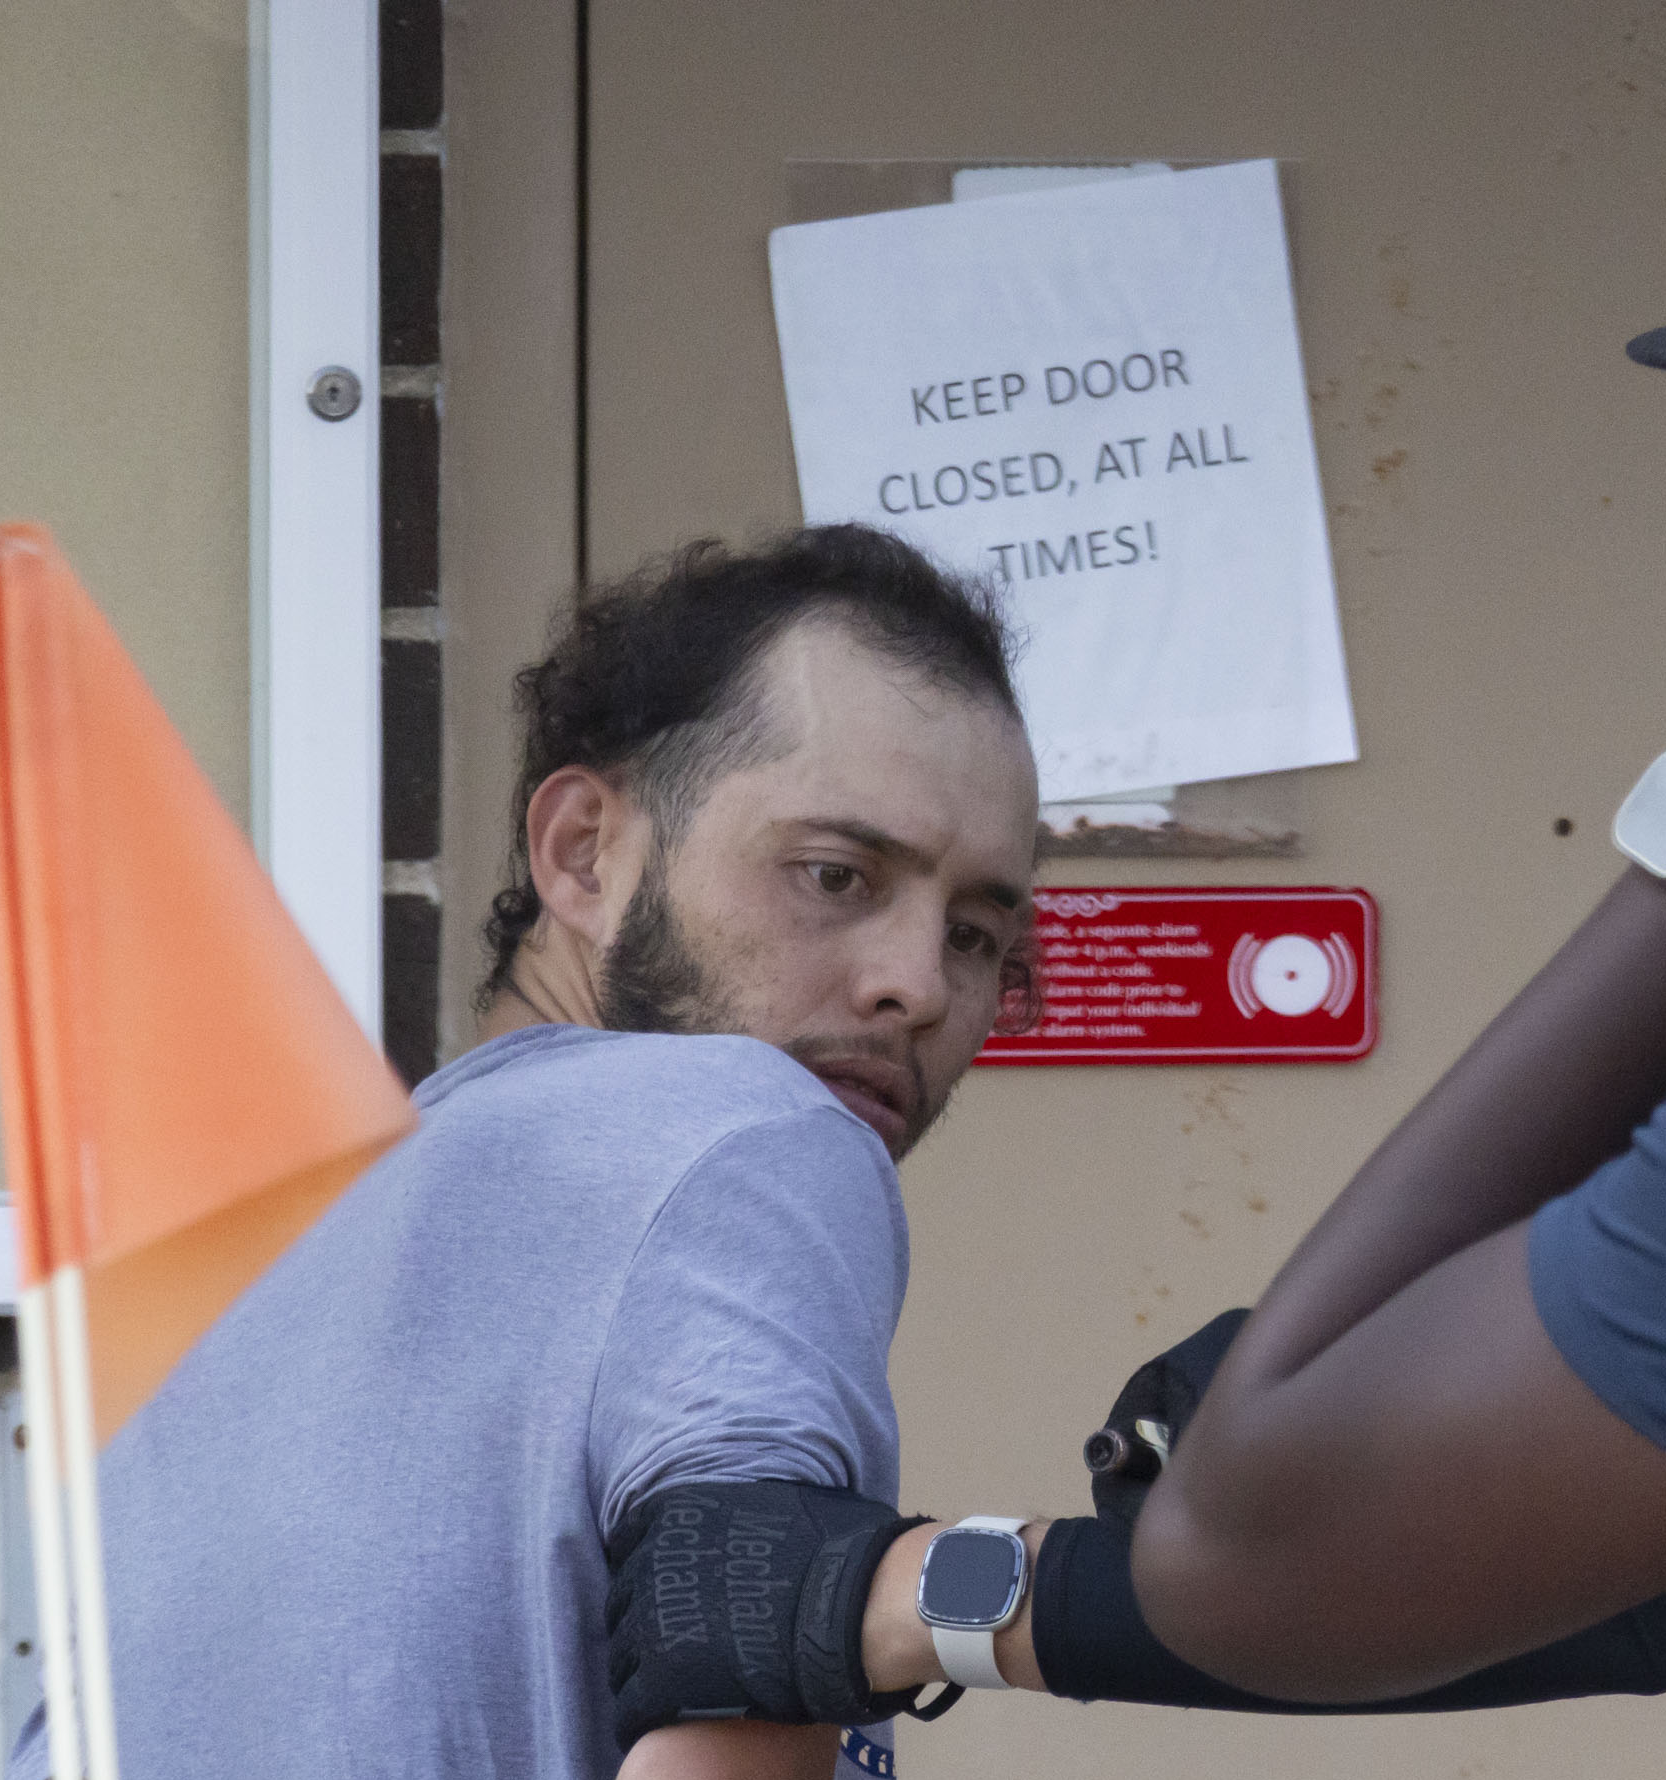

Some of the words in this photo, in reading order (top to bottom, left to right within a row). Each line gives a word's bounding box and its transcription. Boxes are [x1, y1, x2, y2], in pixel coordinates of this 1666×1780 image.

[910, 372, 1027, 426] KEEP
[1043, 348, 1190, 406] DOOR
[878, 450, 1079, 515] CLOSED,
[1093, 436, 1148, 484] AT
[1165, 423, 1250, 474] ALL
[987, 520, 1159, 584] TIMES!
[1087, 924, 1151, 941] separate
[1153, 922, 1201, 938] alarm
[1085, 982, 1125, 998] code
[1164, 983, 1187, 997] to
[1086, 1004, 1122, 1020] your
[1123, 1000, 1202, 1018] individual
